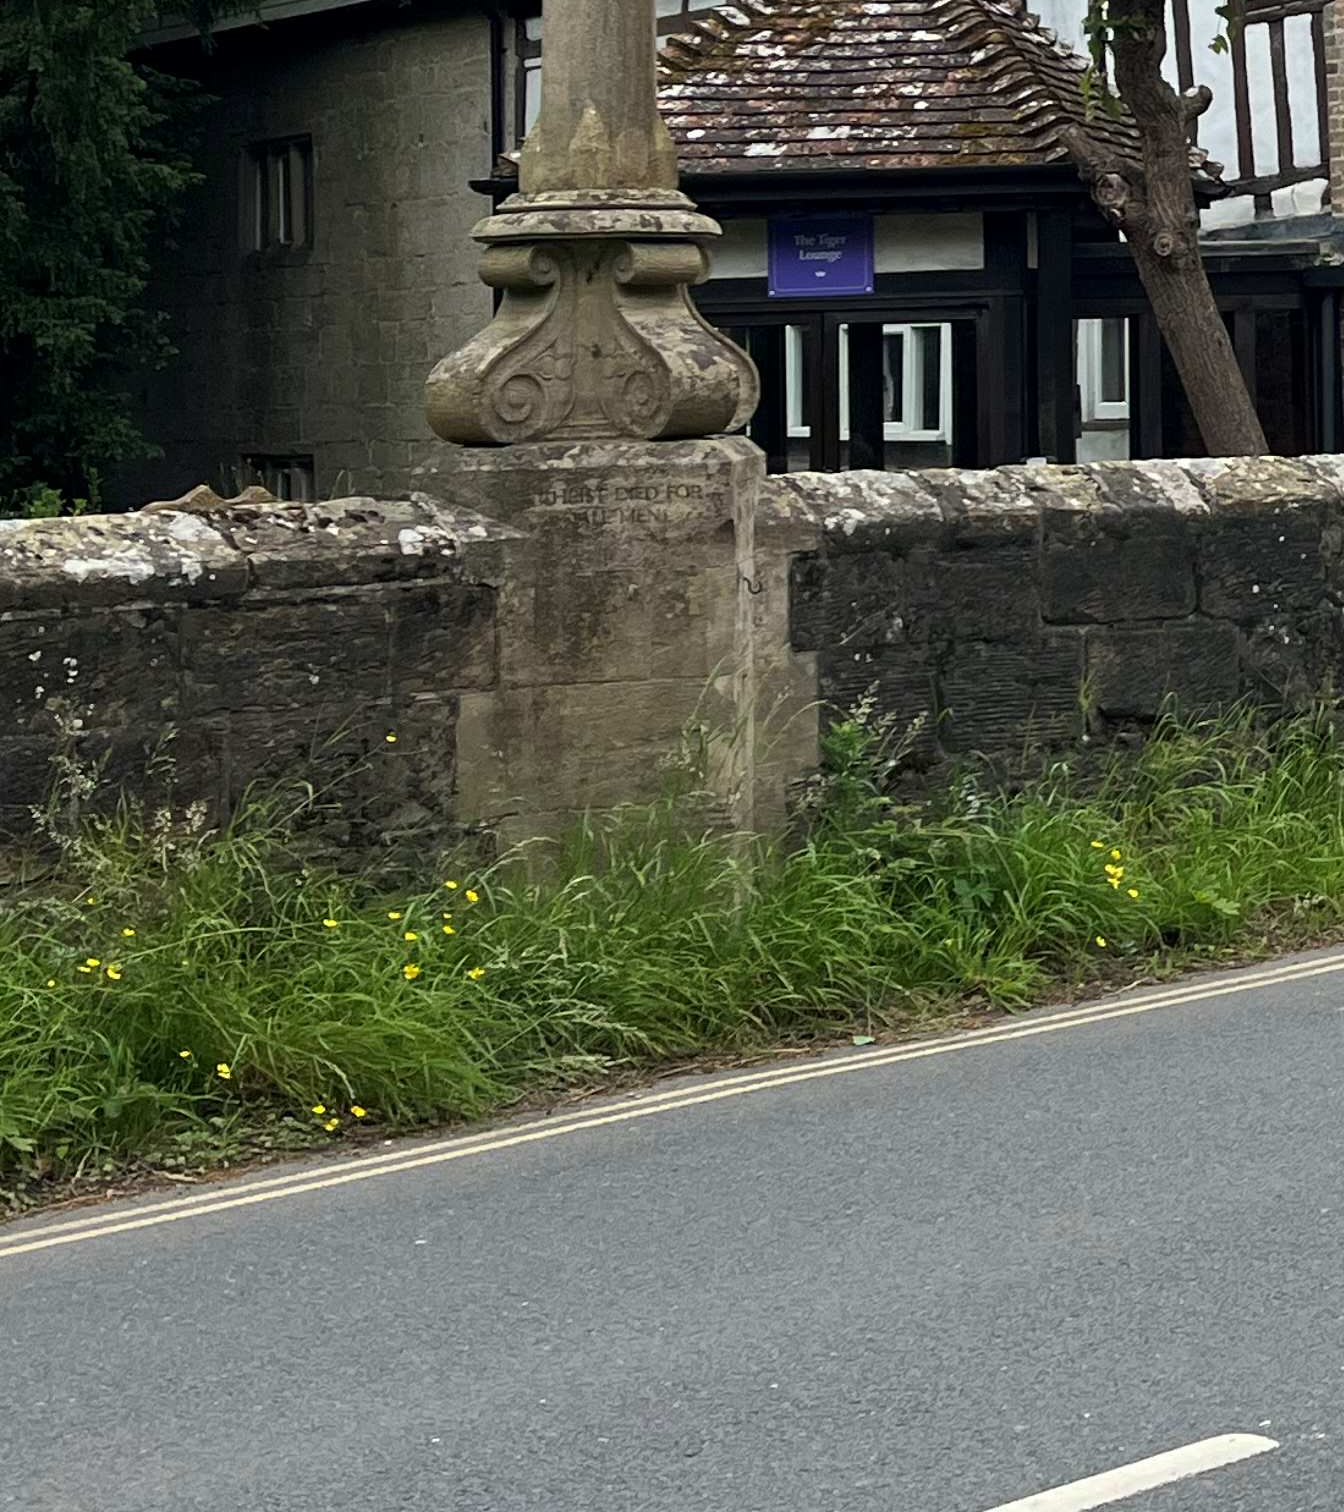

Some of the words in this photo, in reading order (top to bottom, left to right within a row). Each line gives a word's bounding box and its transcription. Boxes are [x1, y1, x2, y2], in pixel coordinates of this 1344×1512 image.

[793, 234, 816, 246] The
[817, 233, 847, 249] Tiger
[799, 249, 843, 263] Lounge
[667, 483, 703, 500] FOR
